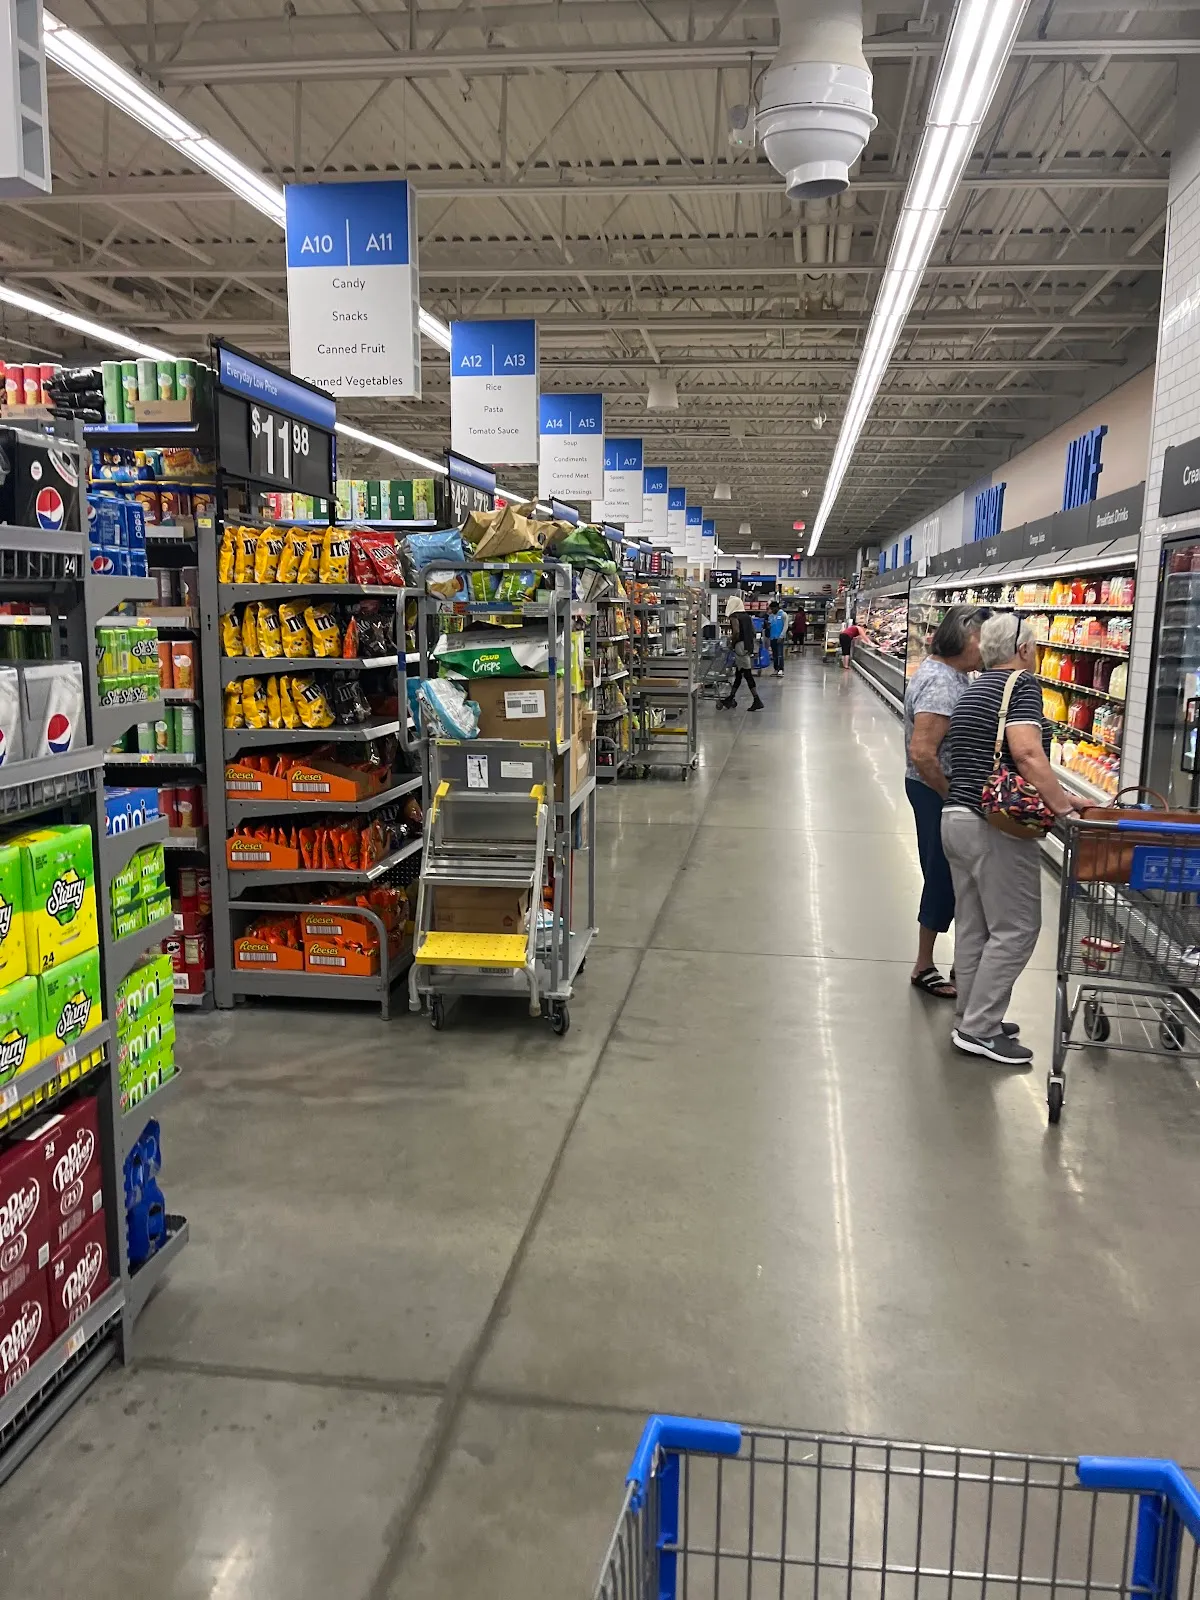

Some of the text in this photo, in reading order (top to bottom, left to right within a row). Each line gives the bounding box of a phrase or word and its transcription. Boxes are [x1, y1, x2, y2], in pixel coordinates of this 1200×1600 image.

[300, 235, 333, 254] A10
[366, 233, 393, 252] A11
[332, 278, 366, 290] Candy
[332, 311, 368, 321] Snacks
[318, 343, 386, 354] Canned Fruit
[460, 354, 482, 368] A12
[504, 354, 526, 366] A13
[227, 362, 278, 396] Everyday Low Price
[346, 376, 403, 388] Vegetables
[546, 419, 563, 428] A14
[578, 418, 596, 428] A15
[624, 458, 636, 466] A17
[1183, 466, 1200, 486] Crea
[549, 488, 592, 496] Salad Dressings
[132, 511, 144, 539] pepsi
[64, 556, 76, 573] 24
[778, 558, 803, 578] PET
[472, 659, 500, 673] Crisps
[112, 798, 146, 835] mini
[142, 858, 160, 878] mini
[116, 869, 134, 889] mini
[46, 879, 84, 916] Starry
[148, 905, 165, 923] mini
[118, 916, 136, 936] mini
[42, 952, 54, 967] 24
[126, 970, 160, 1015] mini
[56, 1000, 92, 1038] Starry
[129, 1016, 162, 1062] mini
[130, 1060, 162, 1108] mini
[46, 1142, 54, 1156] 24
[68, 1138, 82, 1167] Dr
[53, 1137, 92, 1192] Pepper
[8, 1187, 25, 1218] Dr
[0, 1186, 36, 1247] Pepper
[54, 1260, 64, 1278] 24
[76, 1252, 90, 1281] Dr
[62, 1250, 99, 1310] Pepper
[11, 1312, 28, 1340] Dr
[0, 1309, 38, 1374] Pepper
